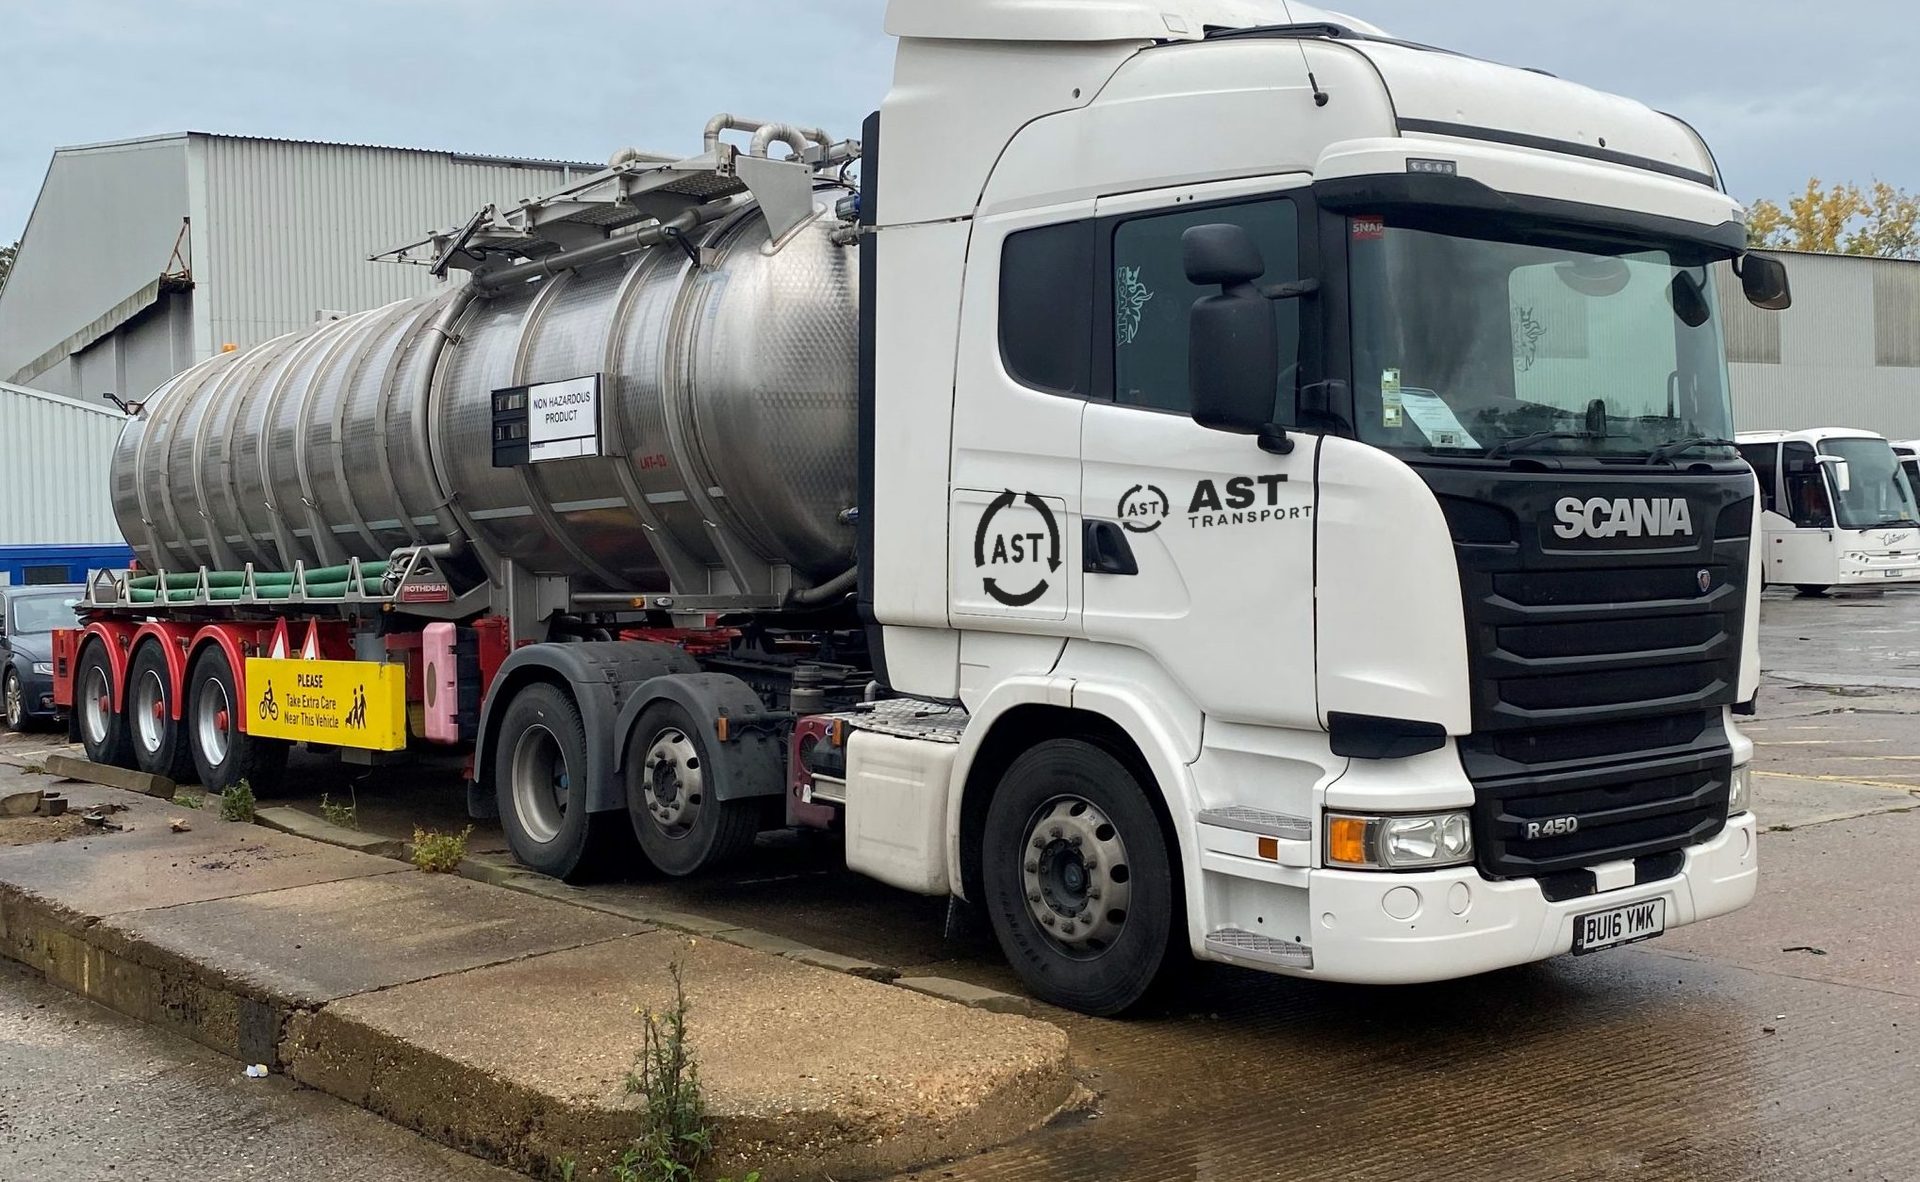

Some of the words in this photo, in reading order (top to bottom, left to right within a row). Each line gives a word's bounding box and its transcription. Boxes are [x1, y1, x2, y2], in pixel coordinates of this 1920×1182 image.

[1353, 222, 1384, 233] SNAP
[533, 398, 548, 409] NON
[549, 391, 591, 407] HAZARDOUS
[545, 409, 578, 424] PRODUCT
[1187, 473, 1288, 514] AST
[1127, 501, 1159, 517] AST
[1188, 505, 1312, 529] TRANSPORT
[1553, 496, 1693, 539] SCANIA
[991, 533, 1044, 564] AST
[404, 584, 448, 593] ROTHDEAN
[297, 673, 323, 688] PLEASE
[286, 693, 301, 708] Take
[302, 694, 320, 710] Extra
[320, 696, 336, 710] Care
[284, 711, 299, 725] Near
[301, 712, 314, 726] This
[315, 714, 339, 729] Vehicle
[1527, 822, 1540, 839] R
[1542, 816, 1578, 836] 450
[1586, 912, 1622, 944] BU16
[1627, 904, 1655, 934] YMK
